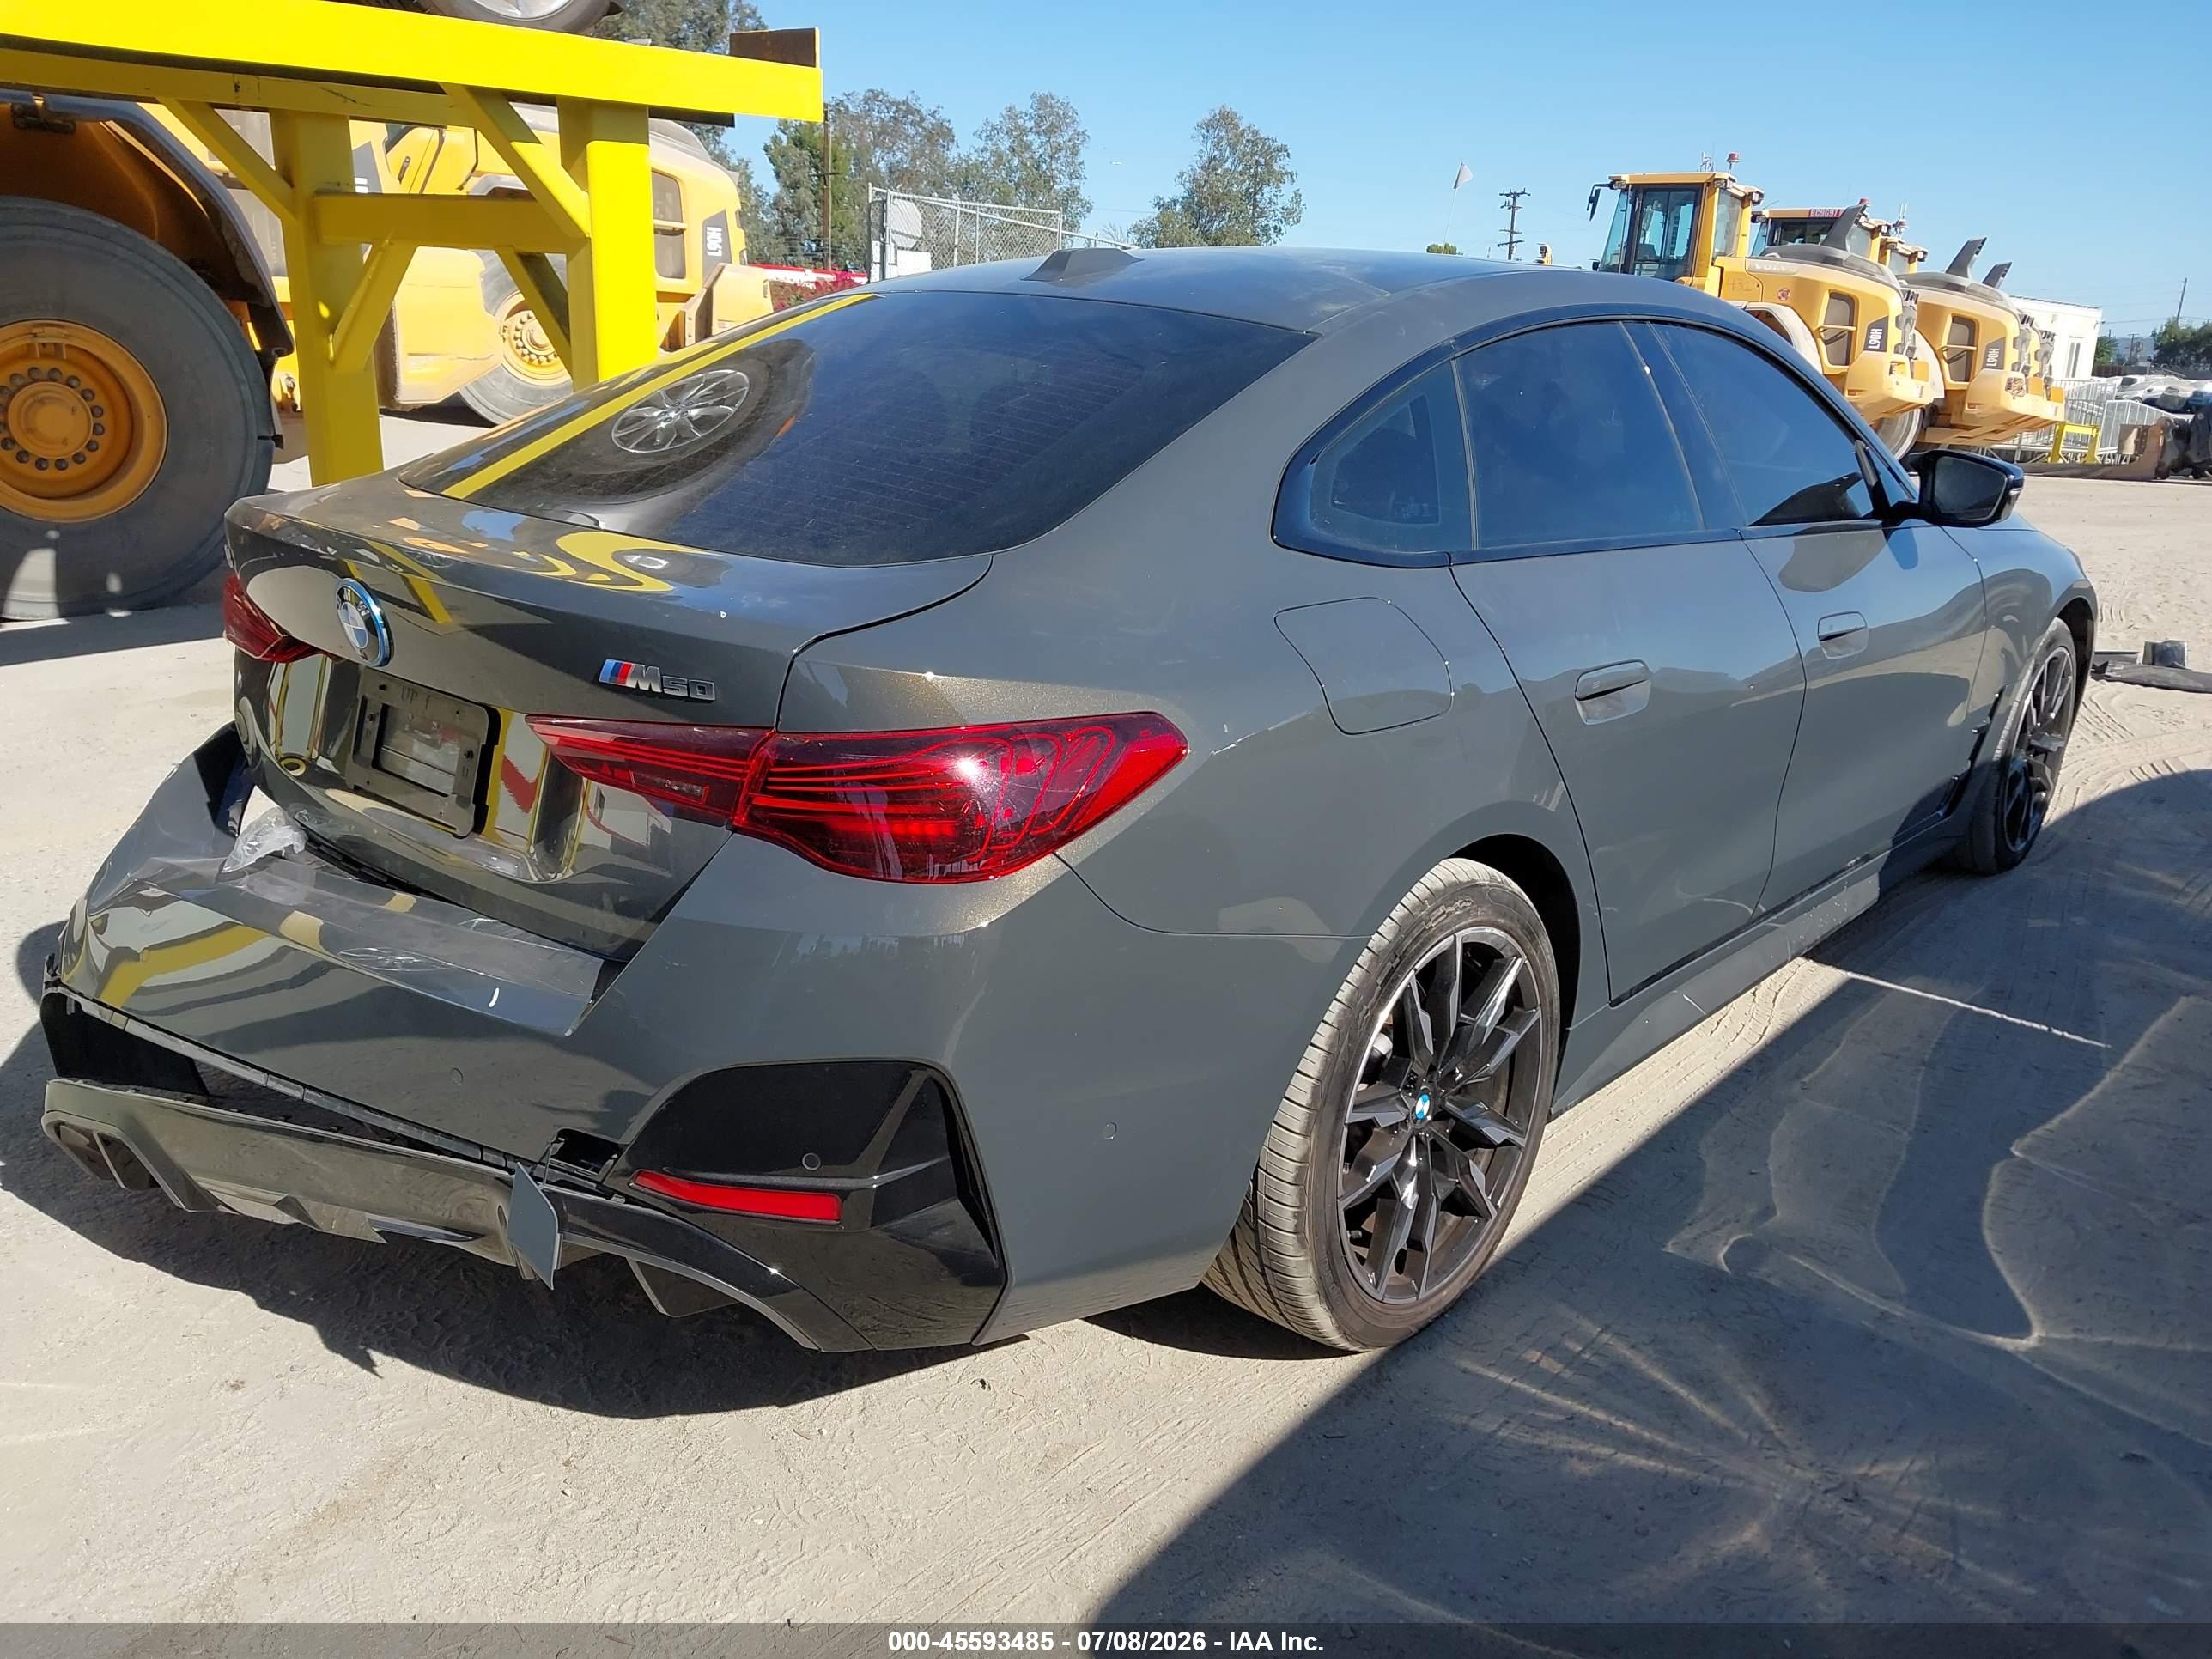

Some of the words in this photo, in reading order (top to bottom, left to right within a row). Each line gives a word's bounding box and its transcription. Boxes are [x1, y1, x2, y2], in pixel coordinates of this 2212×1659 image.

[706, 226, 722, 257] L90H
[1868, 327, 1883, 349] L90H
[1986, 347, 2000, 368] L90H
[625, 662, 716, 701] M50
